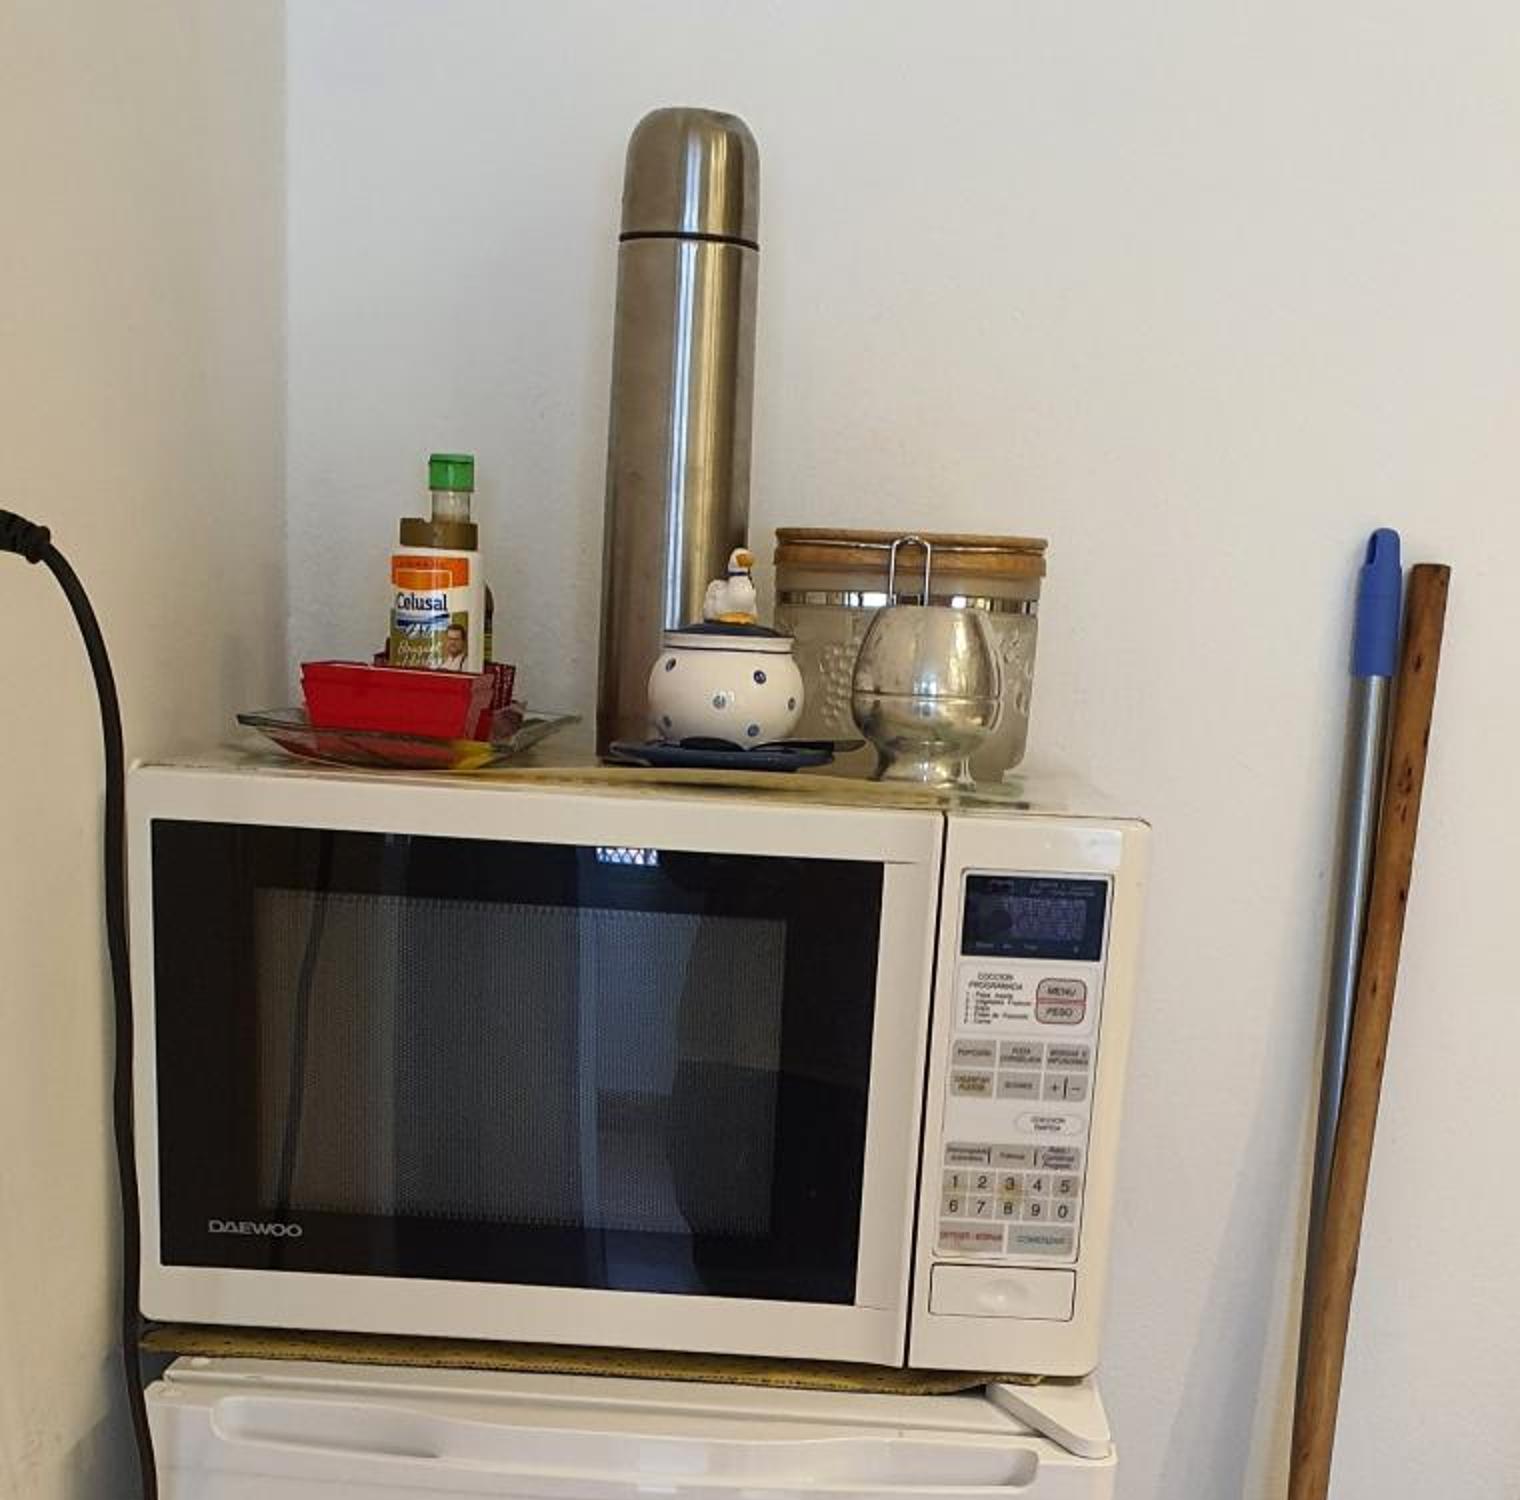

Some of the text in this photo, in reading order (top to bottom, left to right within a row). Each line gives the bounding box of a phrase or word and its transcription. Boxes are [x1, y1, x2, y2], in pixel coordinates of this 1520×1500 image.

[396, 592, 448, 612] Celusal
[1047, 987, 1077, 996] MENU
[1046, 1008, 1073, 1017] PESO
[951, 1175, 1070, 1193] 1 2 3 4 5
[949, 1199, 1068, 1218] 6 7 8 9 0
[208, 1219, 303, 1237] DAEWOO
